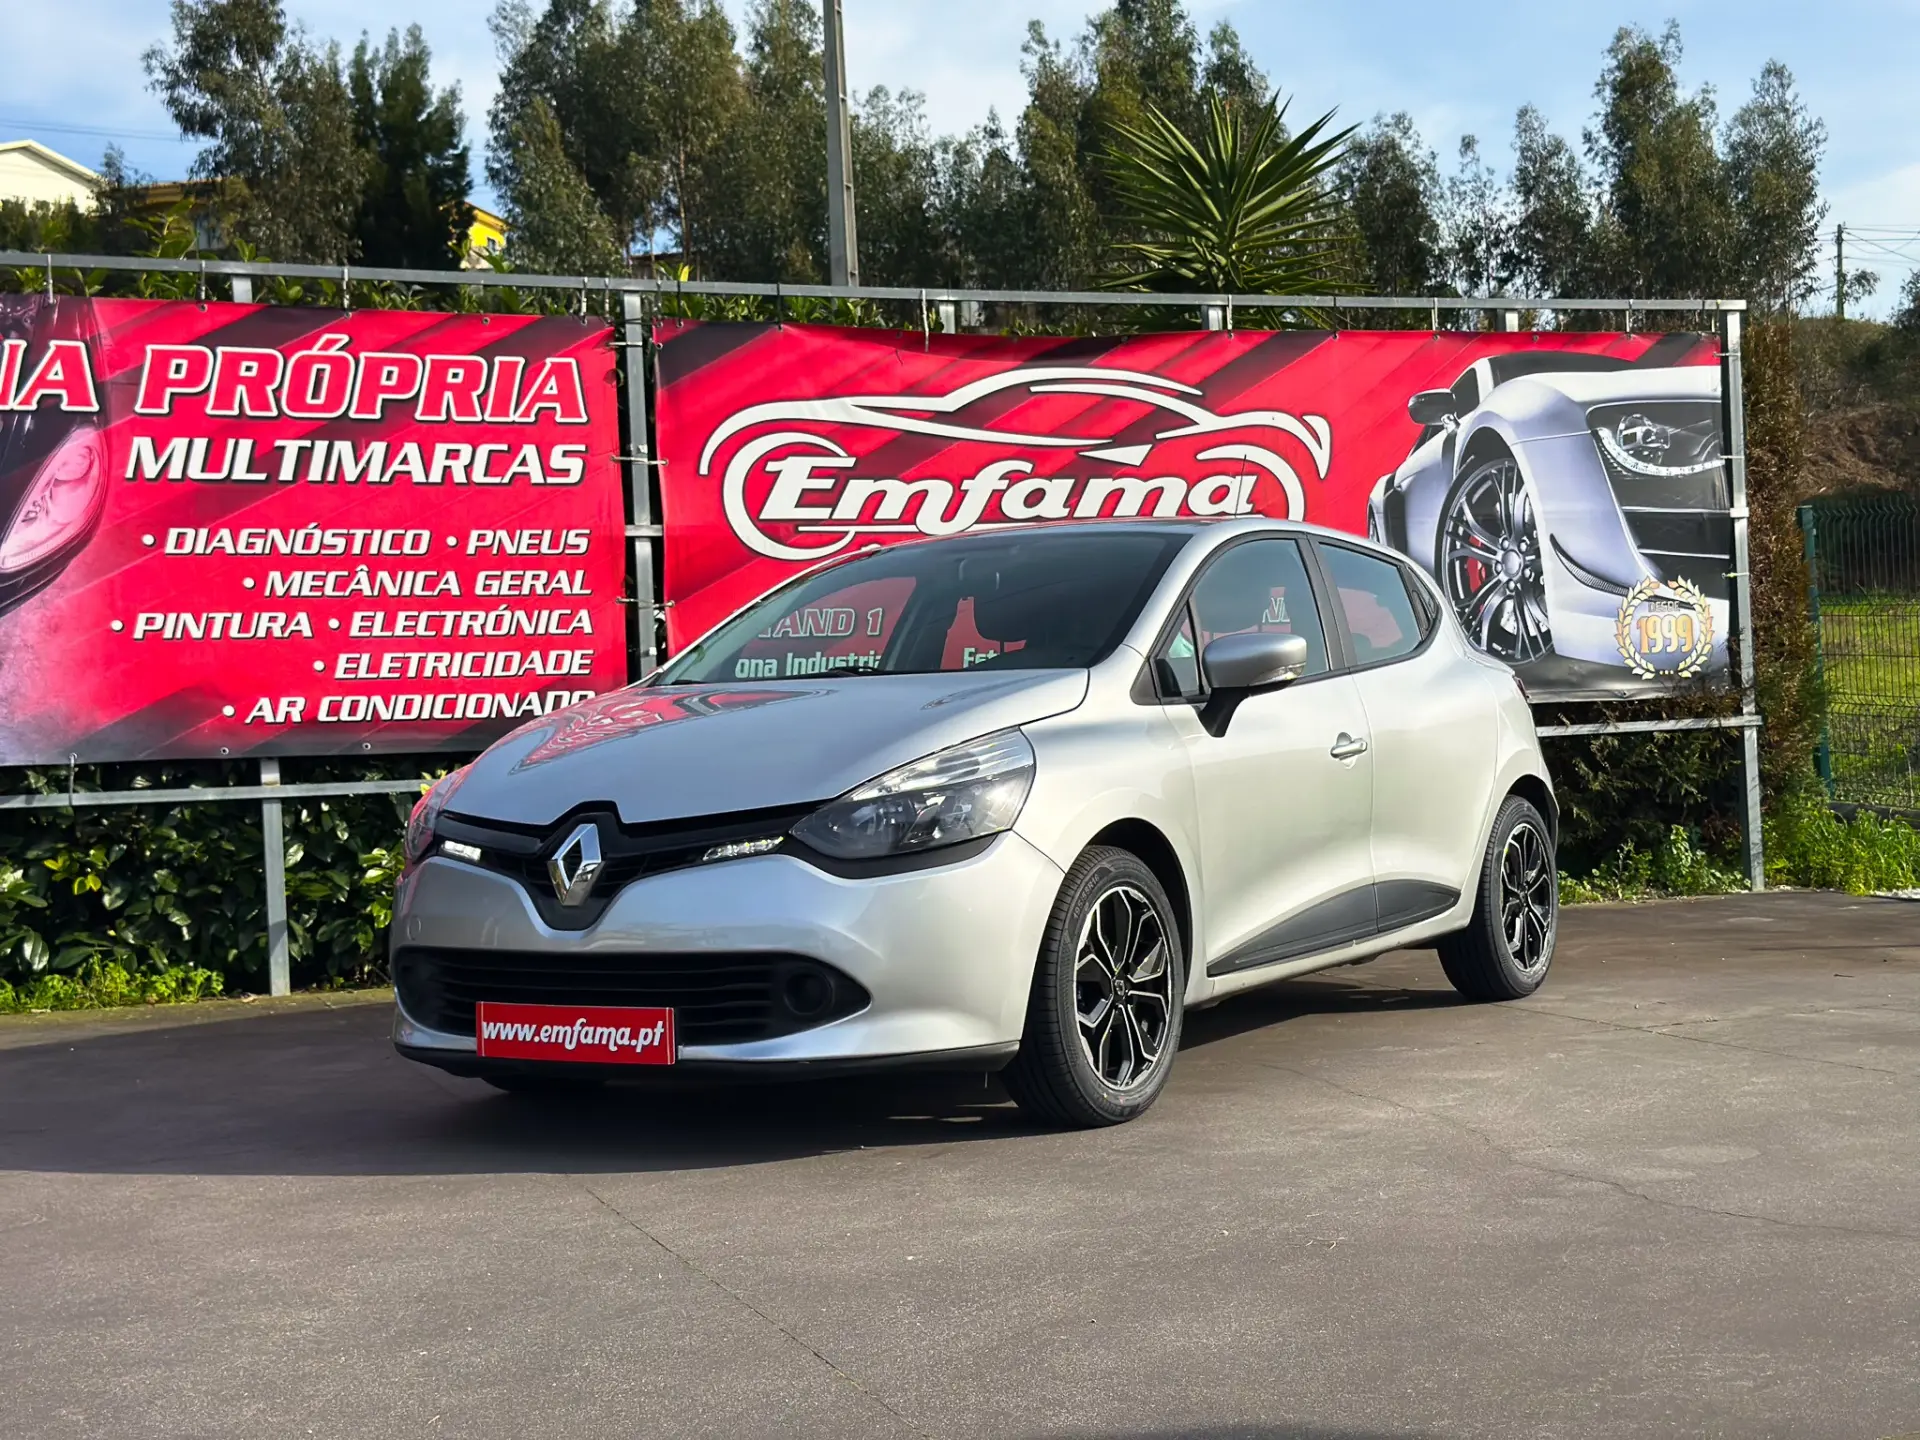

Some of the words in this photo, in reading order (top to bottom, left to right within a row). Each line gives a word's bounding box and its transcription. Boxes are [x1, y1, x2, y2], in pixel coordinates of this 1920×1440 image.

[133, 334, 589, 423] PRÓPRIA
[124, 436, 586, 485] MULTIMARCAS
[758, 455, 1256, 536] Emfama
[164, 522, 431, 556] DIAGNÓSTICO
[466, 529, 591, 556] PNEUS
[263, 564, 461, 597] MECÂNICA
[474, 569, 592, 596] GERAL
[133, 611, 314, 640] PINTURA
[349, 603, 593, 637] ELECTRÓNICA
[759, 607, 856, 638] AND
[1637, 614, 1693, 654] 1999
[334, 649, 594, 680] ELETRICIDADE
[735, 657, 778, 679] ona
[244, 695, 303, 725] AR
[483, 1017, 665, 1052] www.emfama.pt
